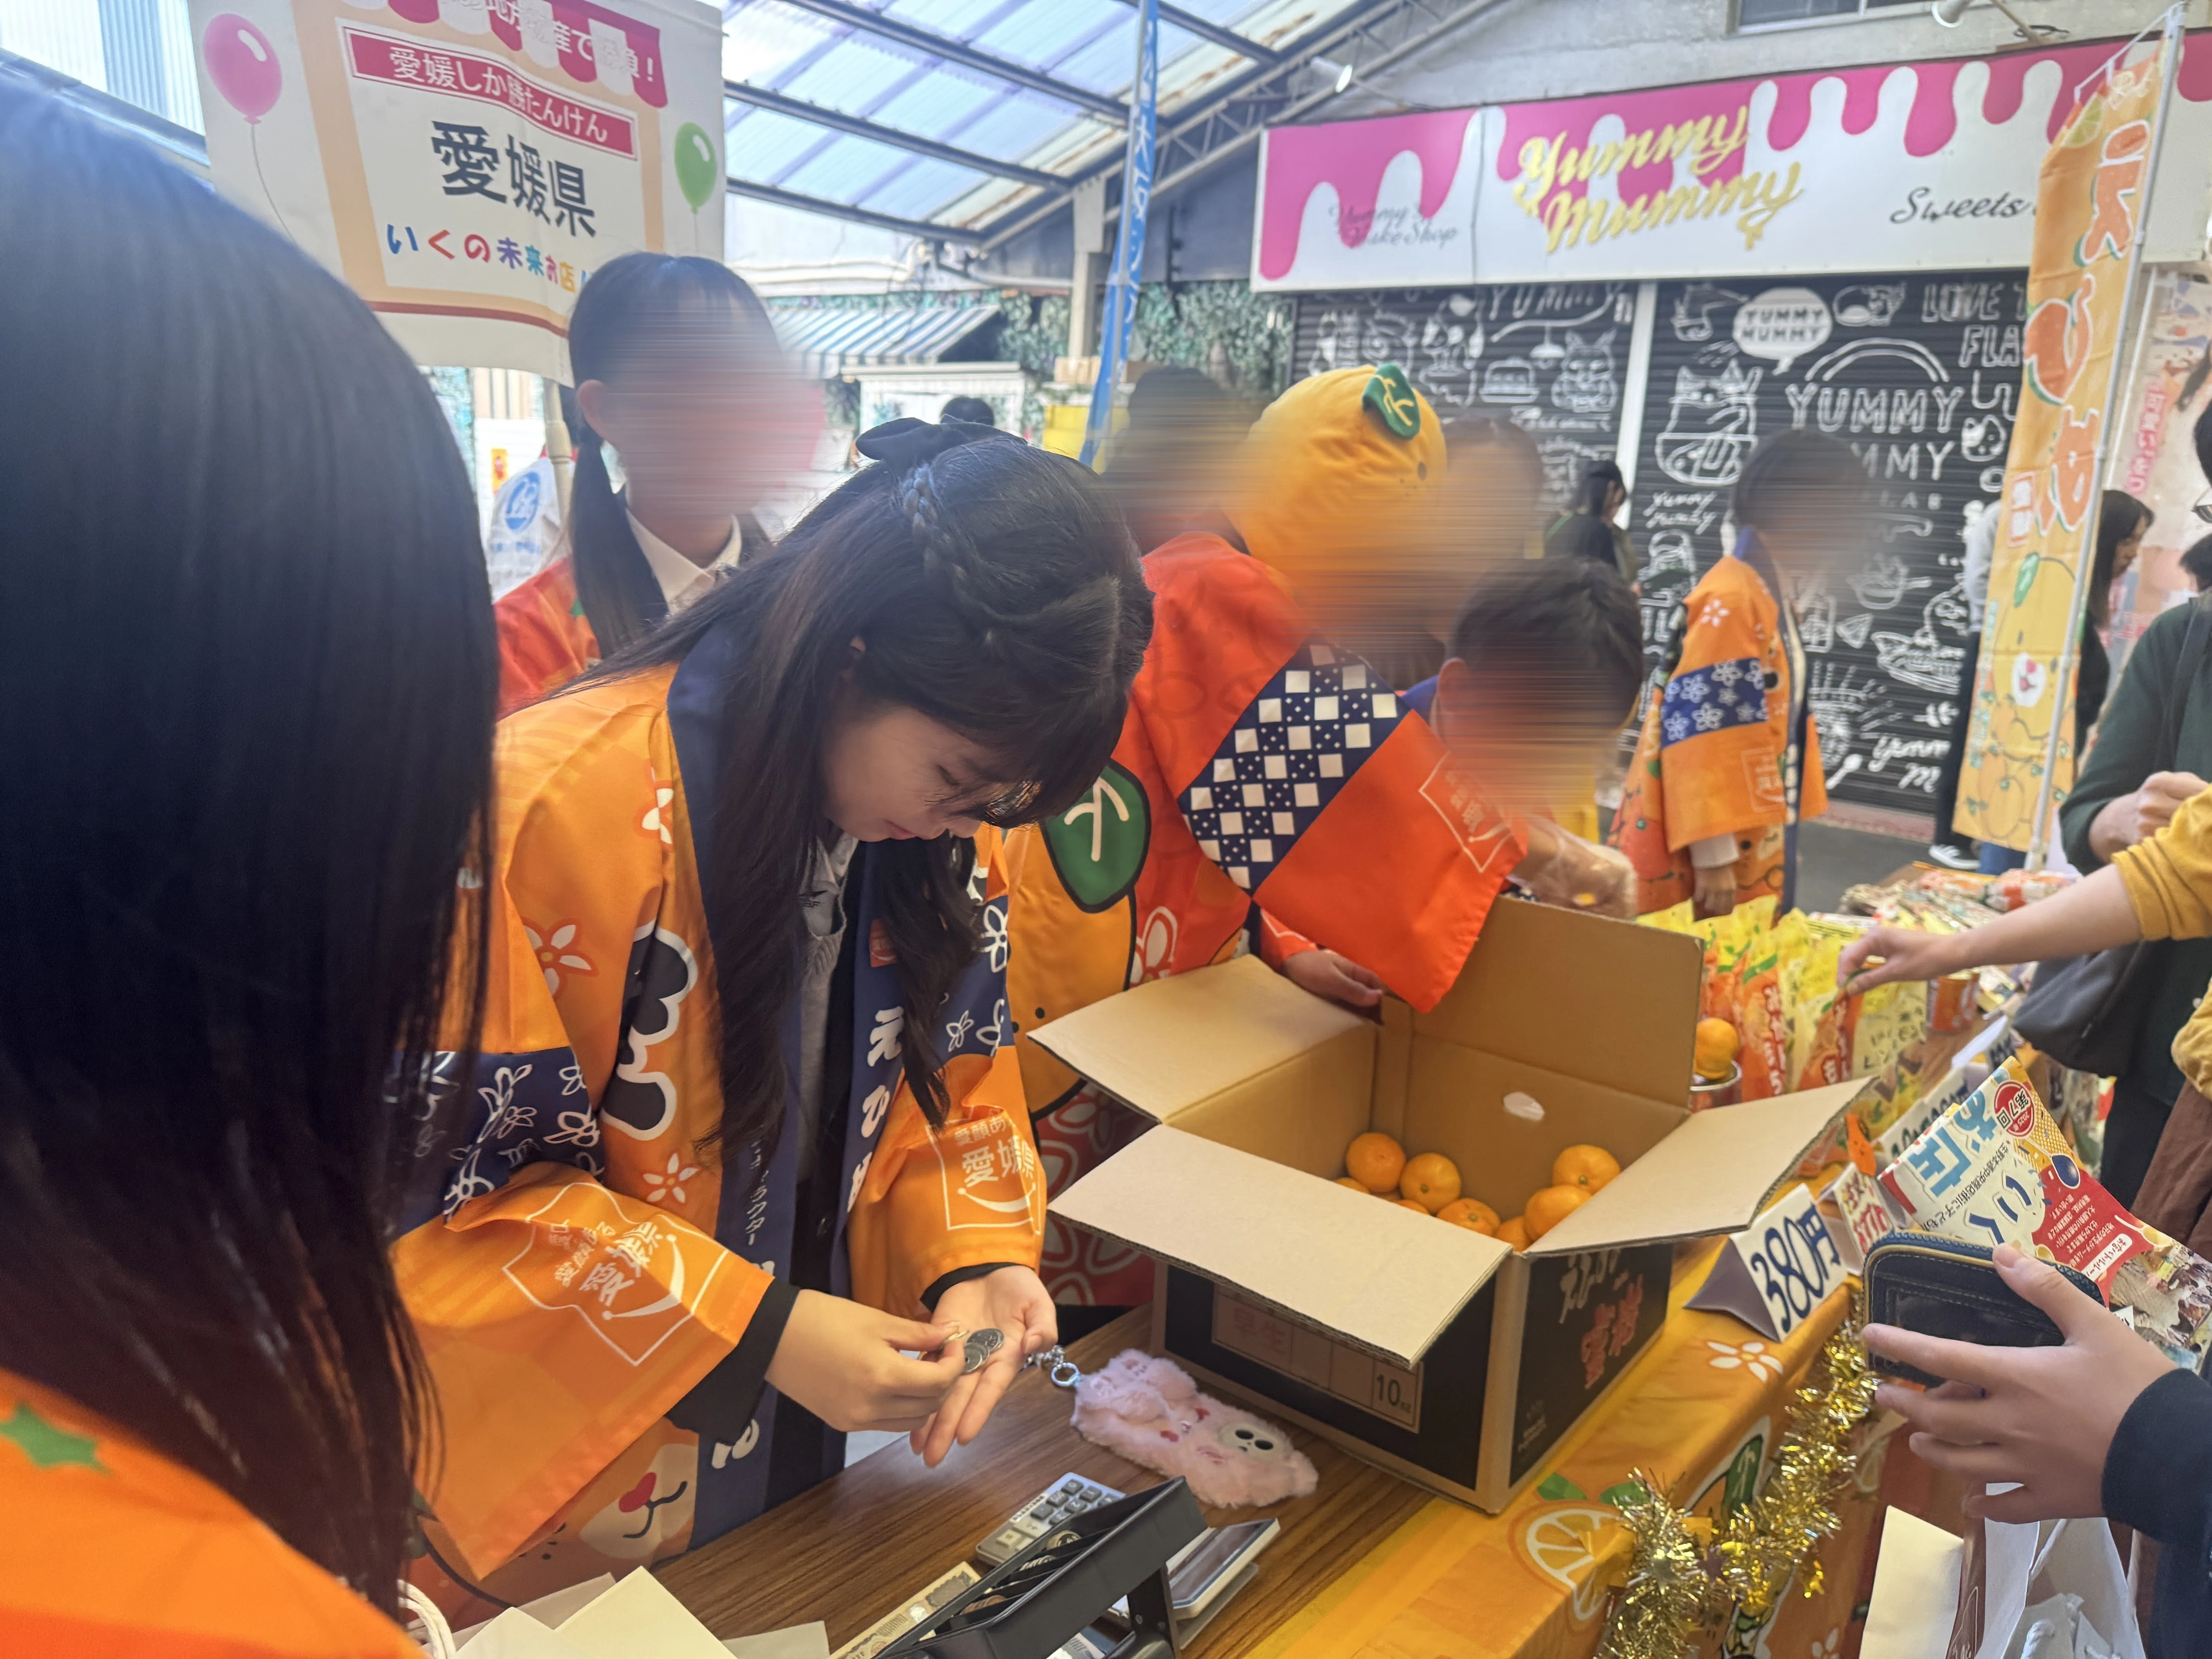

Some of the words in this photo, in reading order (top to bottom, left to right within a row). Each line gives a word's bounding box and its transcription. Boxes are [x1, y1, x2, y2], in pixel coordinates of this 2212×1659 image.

[390, 46, 607, 142] 愛媛しか勝たんけん
[431, 120, 596, 237] 愛媛県
[1513, 105, 1750, 217] Yummy
[1544, 161, 1805, 254] Mummy
[1889, 186, 2028, 224] Sweets
[1958, 324, 2021, 368] FLA
[1785, 382, 1965, 434] YUMMY
[1850, 441, 1955, 481] MMY
[1997, 1091, 2029, 1129] 第7回
[962, 1135, 1034, 1188] 愛媛県
[1750, 1200, 1841, 1333] 380円
